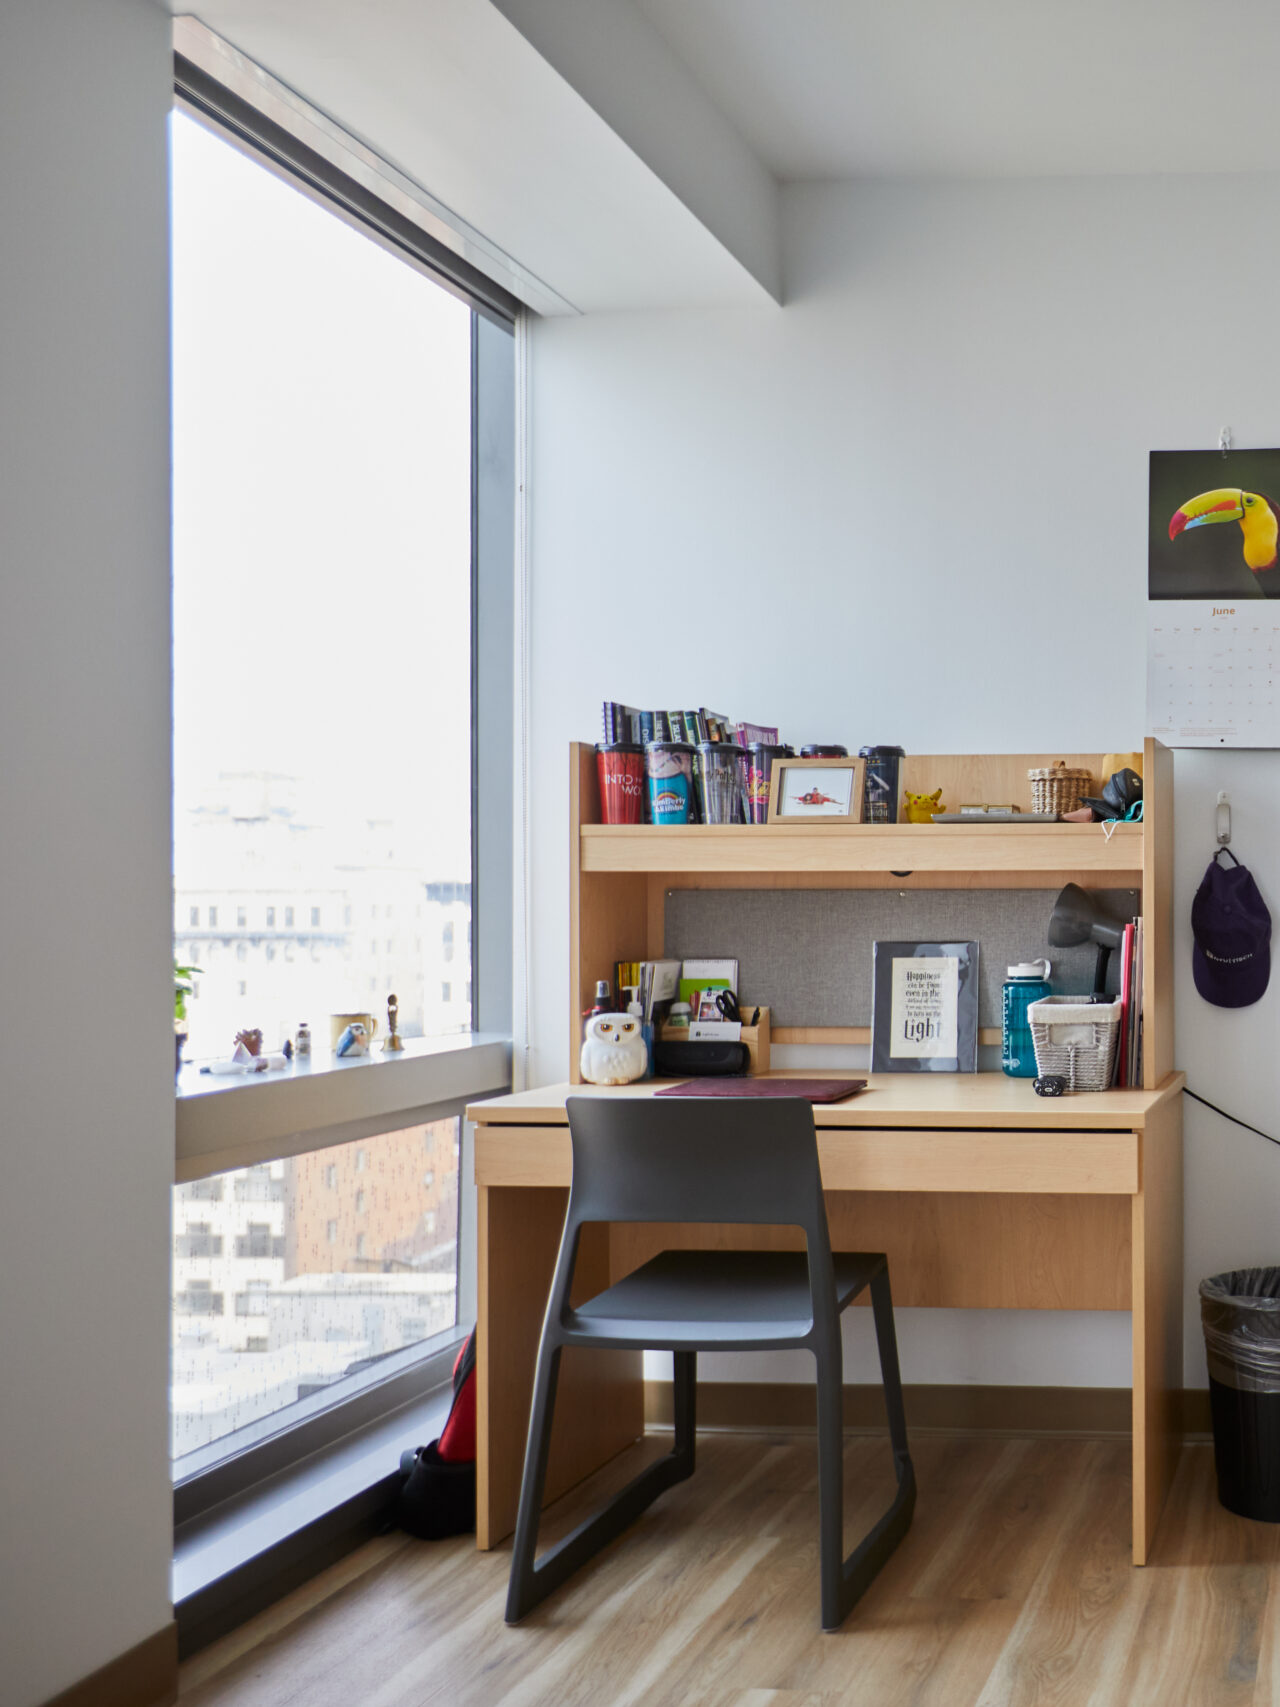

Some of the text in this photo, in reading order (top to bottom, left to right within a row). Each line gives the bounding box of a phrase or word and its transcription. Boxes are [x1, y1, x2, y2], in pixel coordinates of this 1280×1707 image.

[1212, 607, 1236, 617] June
[605, 774, 633, 785] INTO
[930, 988, 940, 997] the
[904, 1018, 942, 1043] Light
